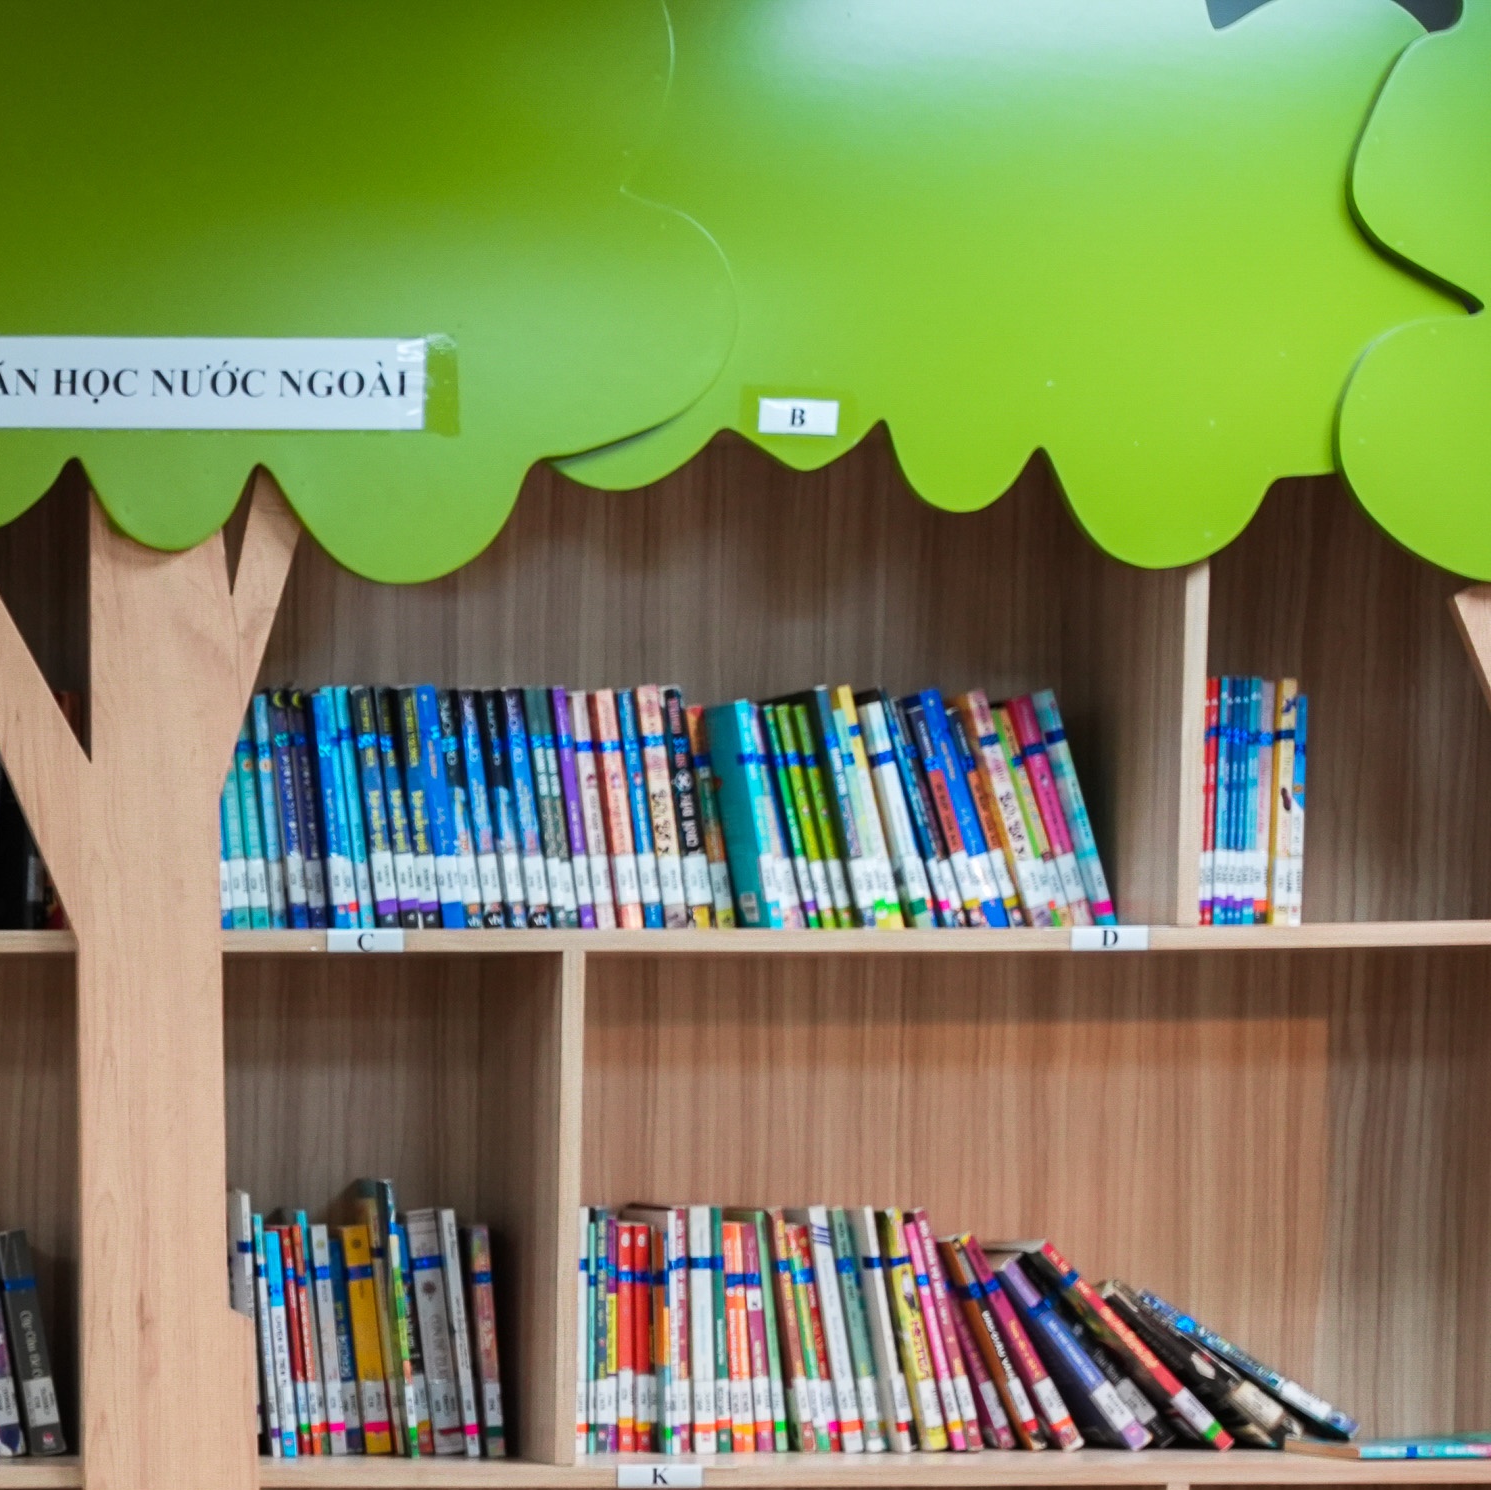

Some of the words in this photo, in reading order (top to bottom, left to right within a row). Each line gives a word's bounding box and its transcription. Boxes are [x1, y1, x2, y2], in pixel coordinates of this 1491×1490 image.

[53, 369, 139, 404] HỌC
[150, 364, 266, 399] NƯỚC
[279, 367, 408, 399] NGOÀI
[789, 407, 806, 428] B
[357, 931, 376, 951] C
[1101, 927, 1118, 948] D
[652, 1468, 669, 1486] K
